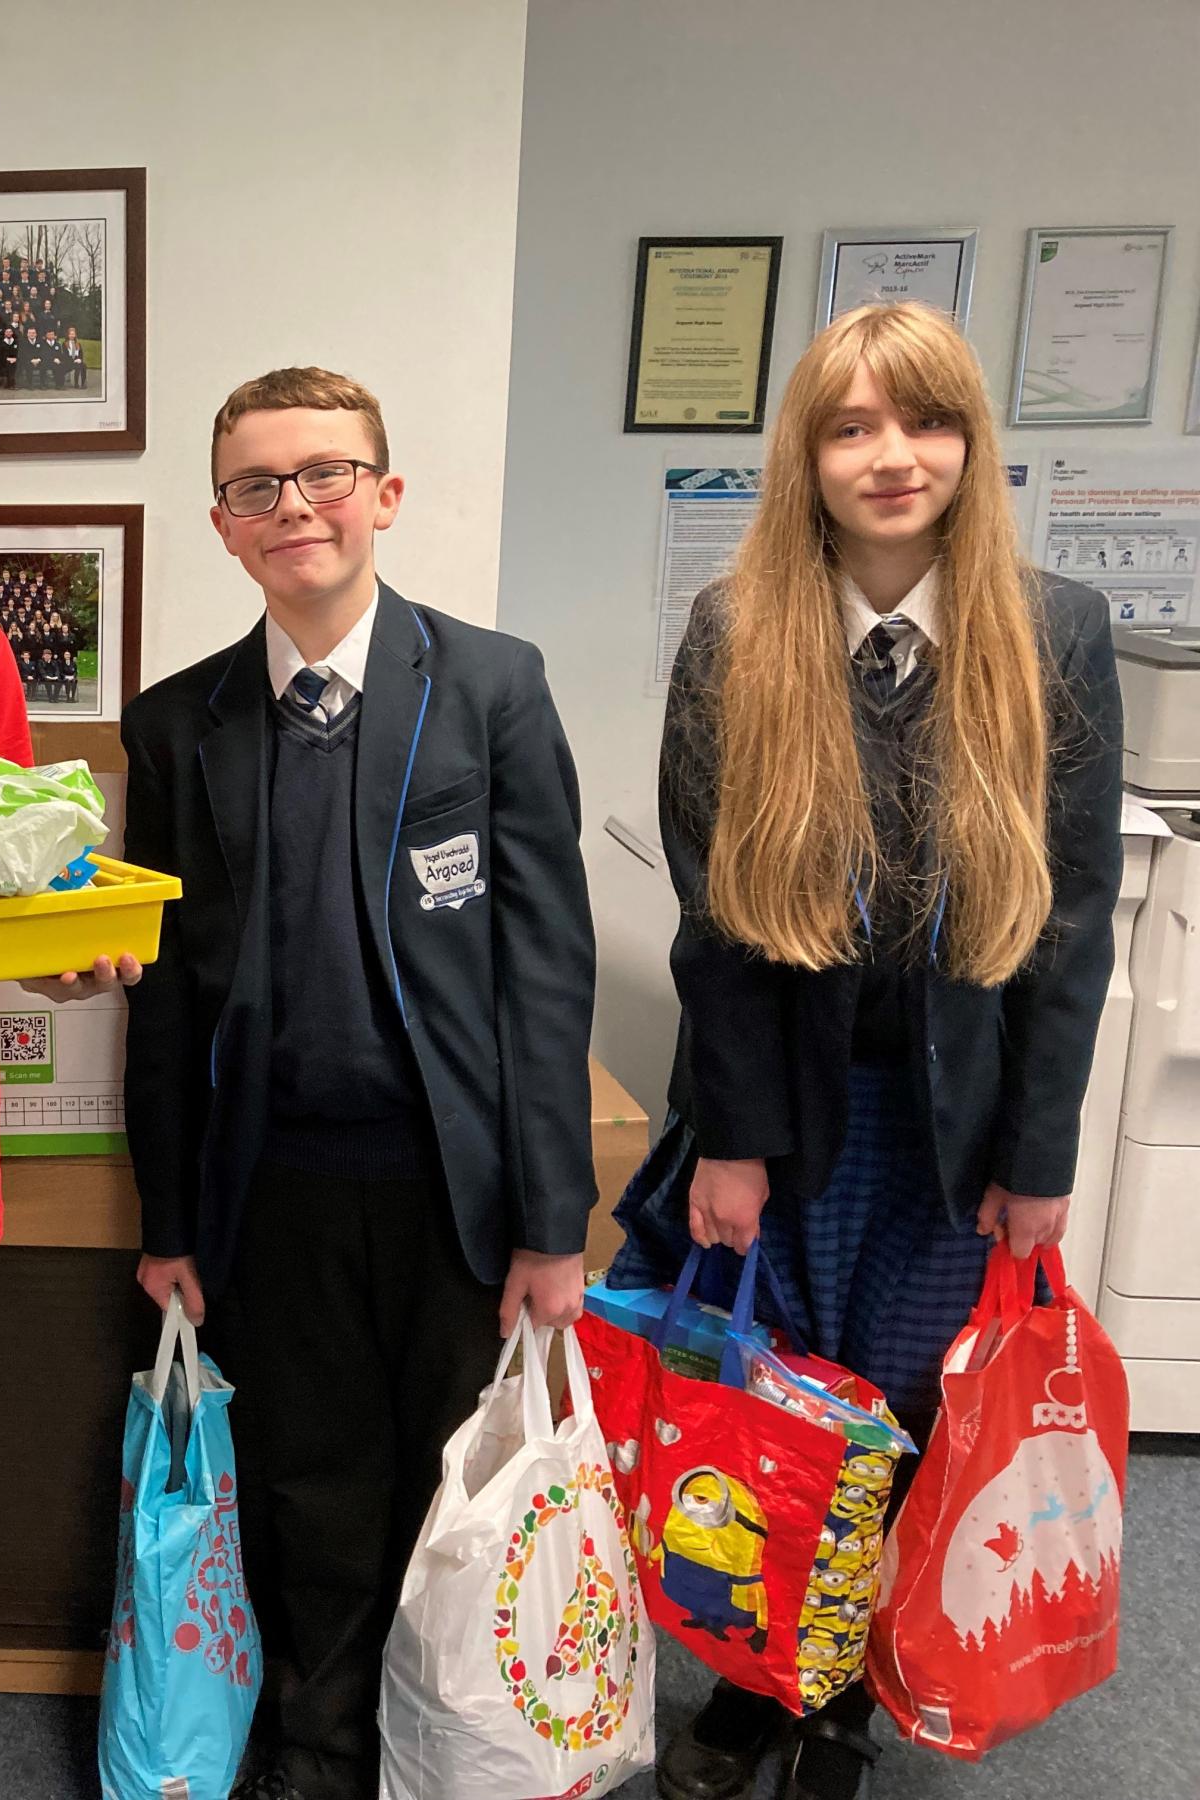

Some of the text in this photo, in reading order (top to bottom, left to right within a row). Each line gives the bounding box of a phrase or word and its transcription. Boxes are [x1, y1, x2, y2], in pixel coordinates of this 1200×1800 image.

[1051, 488, 1075, 496] Guide
[1087, 489, 1121, 497] donning
[1050, 497, 1086, 505] Personal
[1087, 497, 1130, 505] Protective
[1131, 497, 1176, 506] Equipment
[1134, 510, 1162, 518] settings
[425, 854, 475, 882] Argoed
[8, 1071, 29, 1080] Scan
